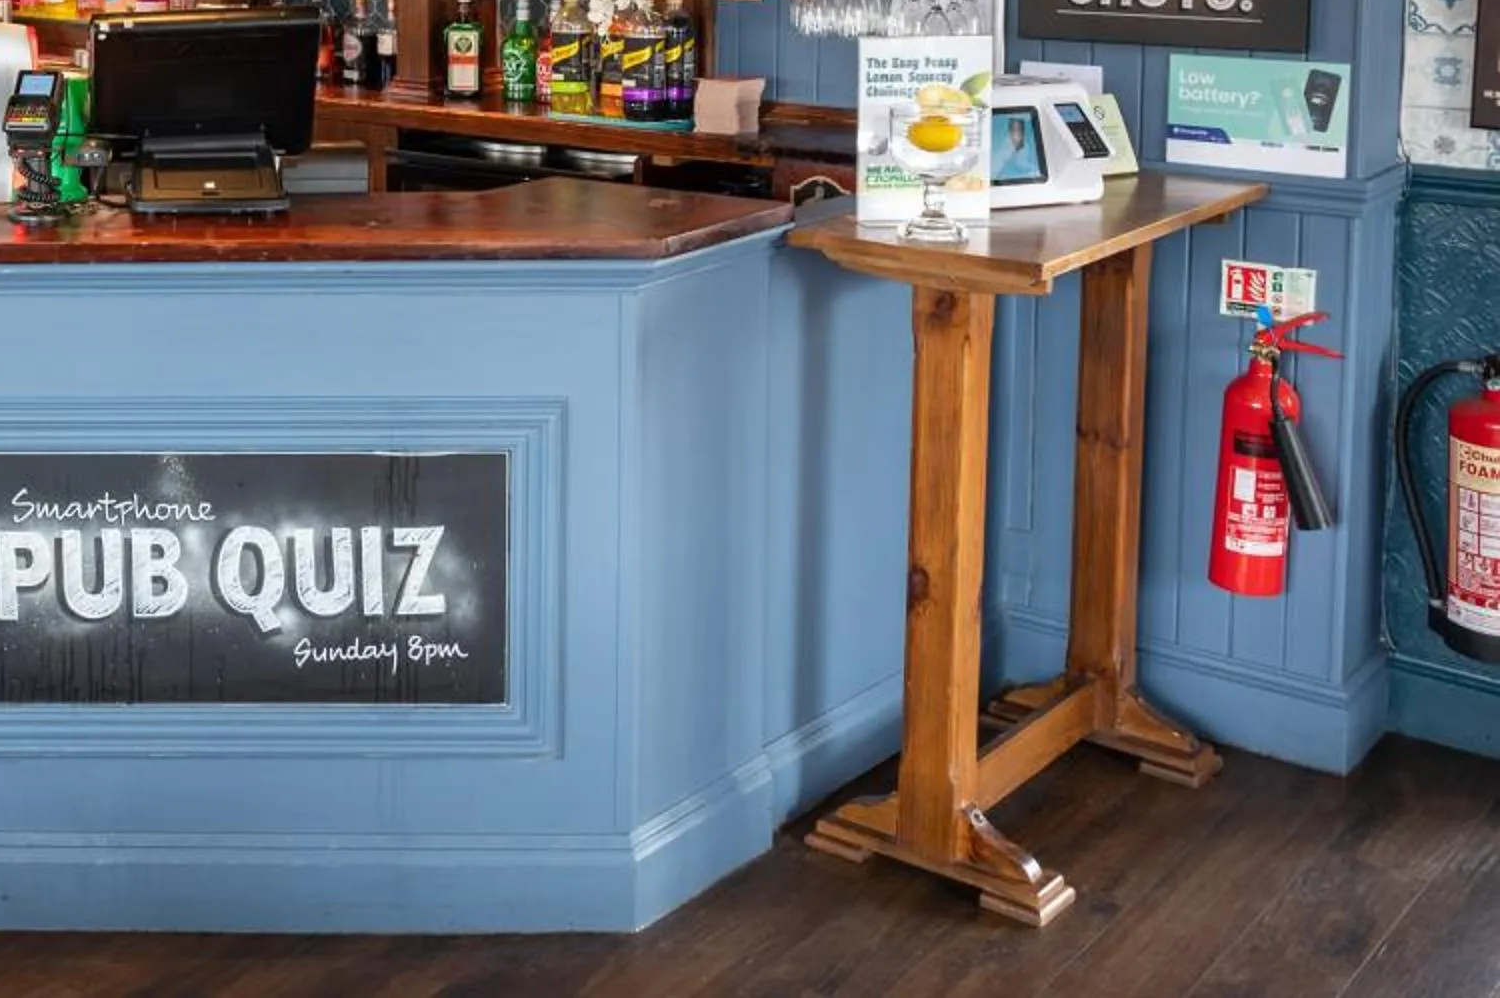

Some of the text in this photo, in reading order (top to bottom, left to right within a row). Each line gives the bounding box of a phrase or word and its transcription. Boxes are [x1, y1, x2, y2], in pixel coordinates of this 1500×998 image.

[866, 57, 888, 69] The
[891, 57, 920, 71] Easy
[1179, 68, 1216, 86] Low
[1178, 86, 1263, 109] battery?
[10, 487, 217, 524] Smartphone
[214, 525, 448, 634] QUIZ
[293, 635, 469, 675] Sunday 8pm
